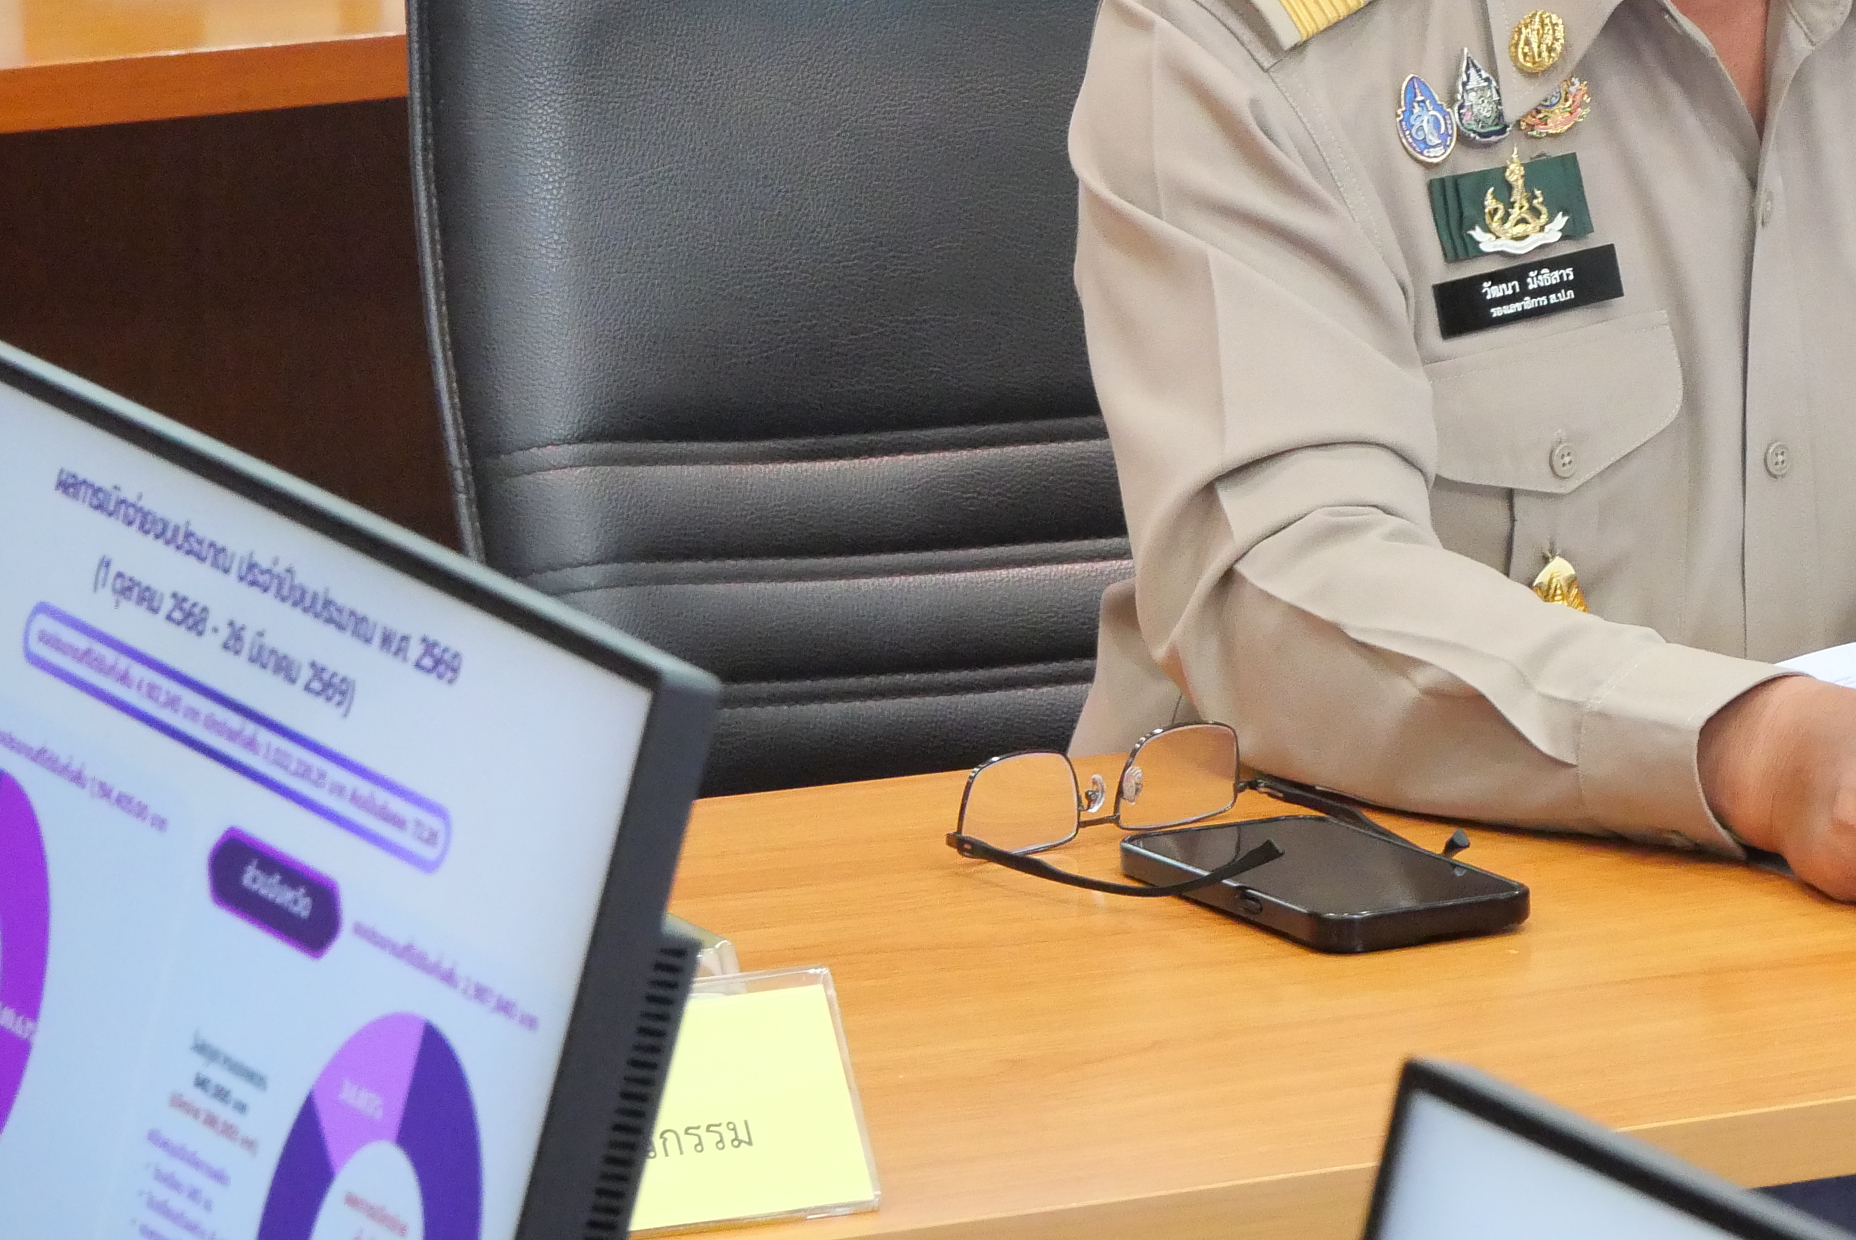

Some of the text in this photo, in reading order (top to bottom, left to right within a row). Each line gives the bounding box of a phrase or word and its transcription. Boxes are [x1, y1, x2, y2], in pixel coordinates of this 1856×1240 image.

[1481, 280, 1520, 299] วัฒนา
[1490, 295, 1548, 317] รองเลขาธิการ
[413, 634, 463, 685] 2569
